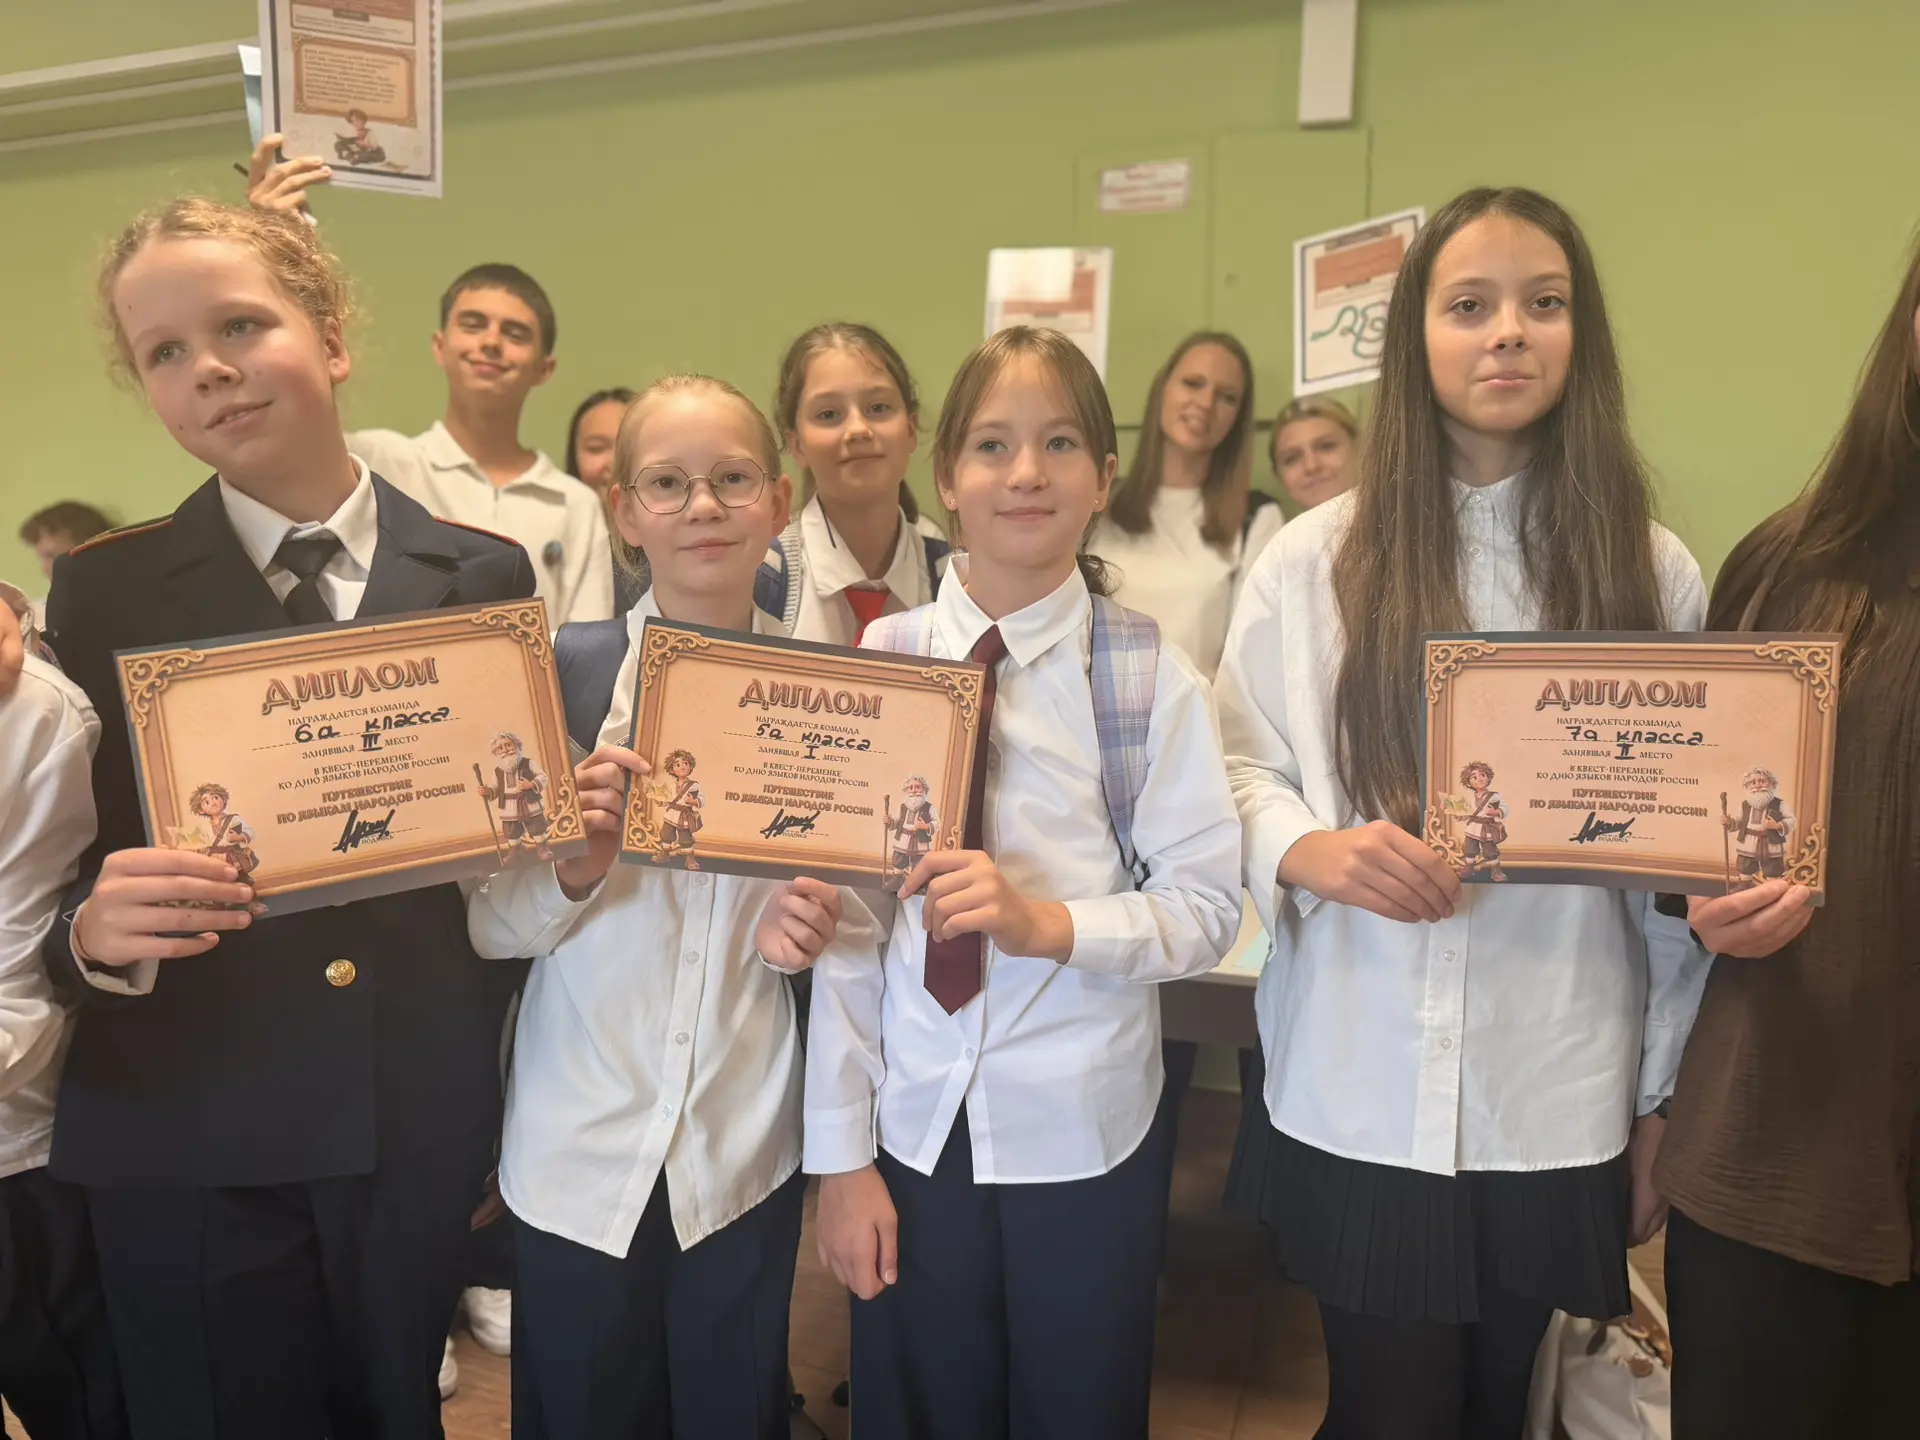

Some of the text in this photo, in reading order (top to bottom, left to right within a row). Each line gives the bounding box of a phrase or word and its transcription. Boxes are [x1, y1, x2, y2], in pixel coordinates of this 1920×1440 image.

[262, 656, 439, 715] ДИПЛОМ
[1535, 678, 1707, 711] ДИПЛОМ
[738, 678, 883, 719] ДИПЛОМ
[288, 700, 420, 726] НАГРАЖДАЕТСЯ КОМАНДА
[1556, 717, 1682, 728] НАГРАЖДАЕТСЯ КОМАНДА
[756, 715, 860, 735] НАГРАЖДАЕТСЯ КОМАНДА
[302, 744, 355, 759] ЗАНЯВШАЯ
[385, 735, 419, 747] МЕСТО
[758, 746, 800, 757] ЗАНЯВШАЯ
[822, 754, 850, 763] МЕСТО
[1562, 749, 1611, 758] ЗАНЯВШАЯ
[1639, 751, 1673, 760] МЕСТО
[278, 756, 450, 790] КО ДНЮ ЯЗЫКОВ НАРОДОВ РОССИИ
[314, 753, 414, 775] В КВЕСТ-ПЕРЕМЕНКЕ
[769, 762, 842, 777] КВЕСТ-ПЕРЕМЕНКЕ
[1576, 765, 1664, 775] КВЕСТ-ПЕРЕМЕНКЕ
[745, 767, 767, 776] ДНЮ
[767, 769, 798, 780] ЯЗЫКОВ
[800, 773, 836, 784] НАРОДОВ
[838, 778, 869, 788] РОССИИ
[1549, 772, 1574, 782] ДНЮ
[1576, 773, 1612, 782] ЯЗЫКОВ
[1613, 774, 1658, 784] НАРОДОВ
[1660, 776, 1699, 786] РОССИИ
[321, 779, 413, 803] ПУТЕШЕСТВИЕ
[763, 784, 835, 800] ПУТЕШЕСТВИЕ
[1572, 788, 1658, 801] ПУТЕШЕСТВИЕ
[277, 783, 466, 825] ПО ЯЗЫКАМ НАРОДОВ РОССИИ
[725, 791, 874, 817] ПО ЯЗЫКАМ НАРОДОВ РОССИИ
[1529, 799, 1708, 817] ПО ЯЗЫКАМ НАРОДОВ РОССИИ
